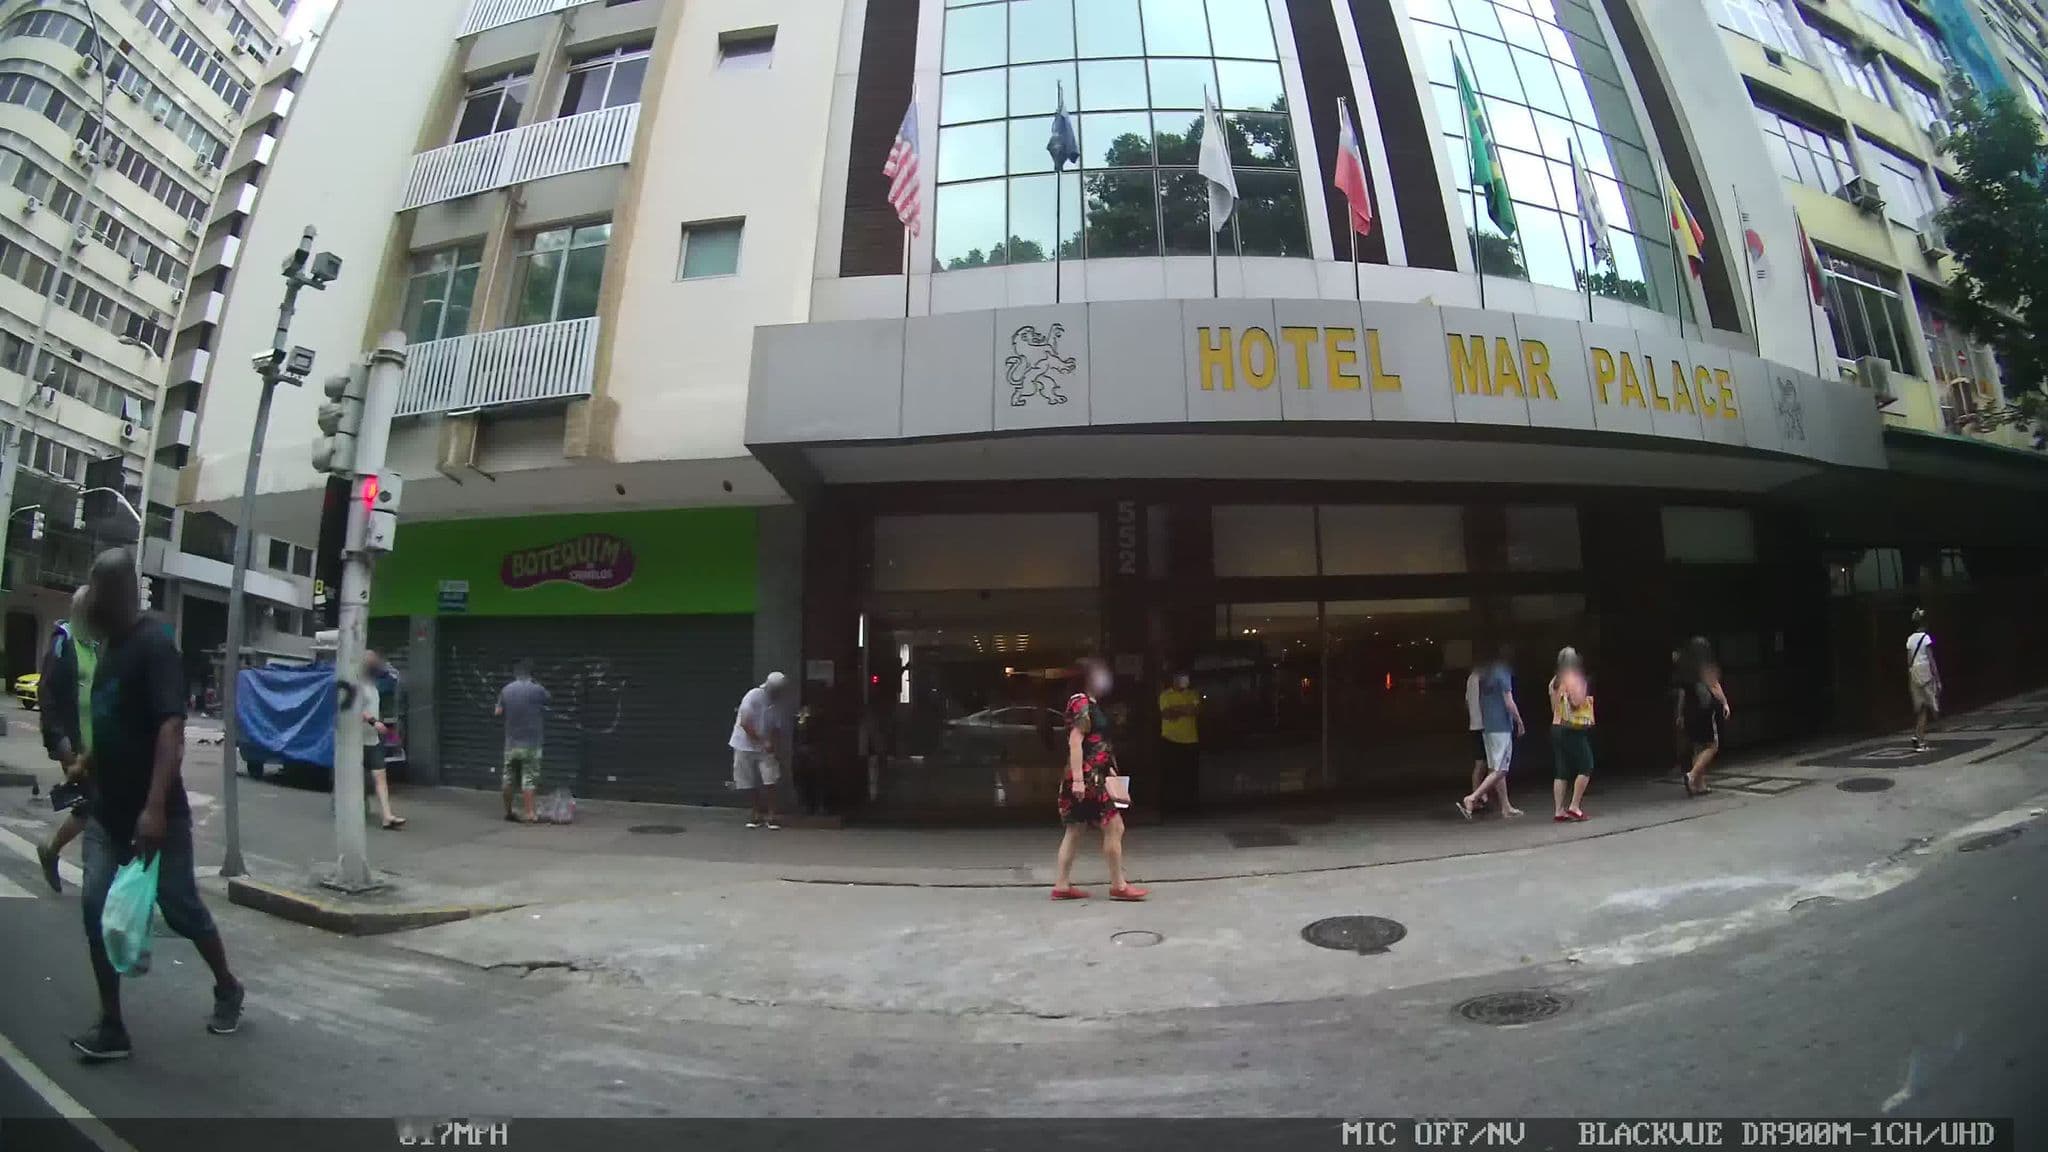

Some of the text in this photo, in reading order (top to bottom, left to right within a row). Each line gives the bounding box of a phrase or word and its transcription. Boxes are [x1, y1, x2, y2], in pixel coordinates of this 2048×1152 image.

[1197, 326, 1738, 419] HOTEL MAR PALACE
[511, 536, 621, 578] BOTEQUIM
[1118, 500, 1136, 575] 552
